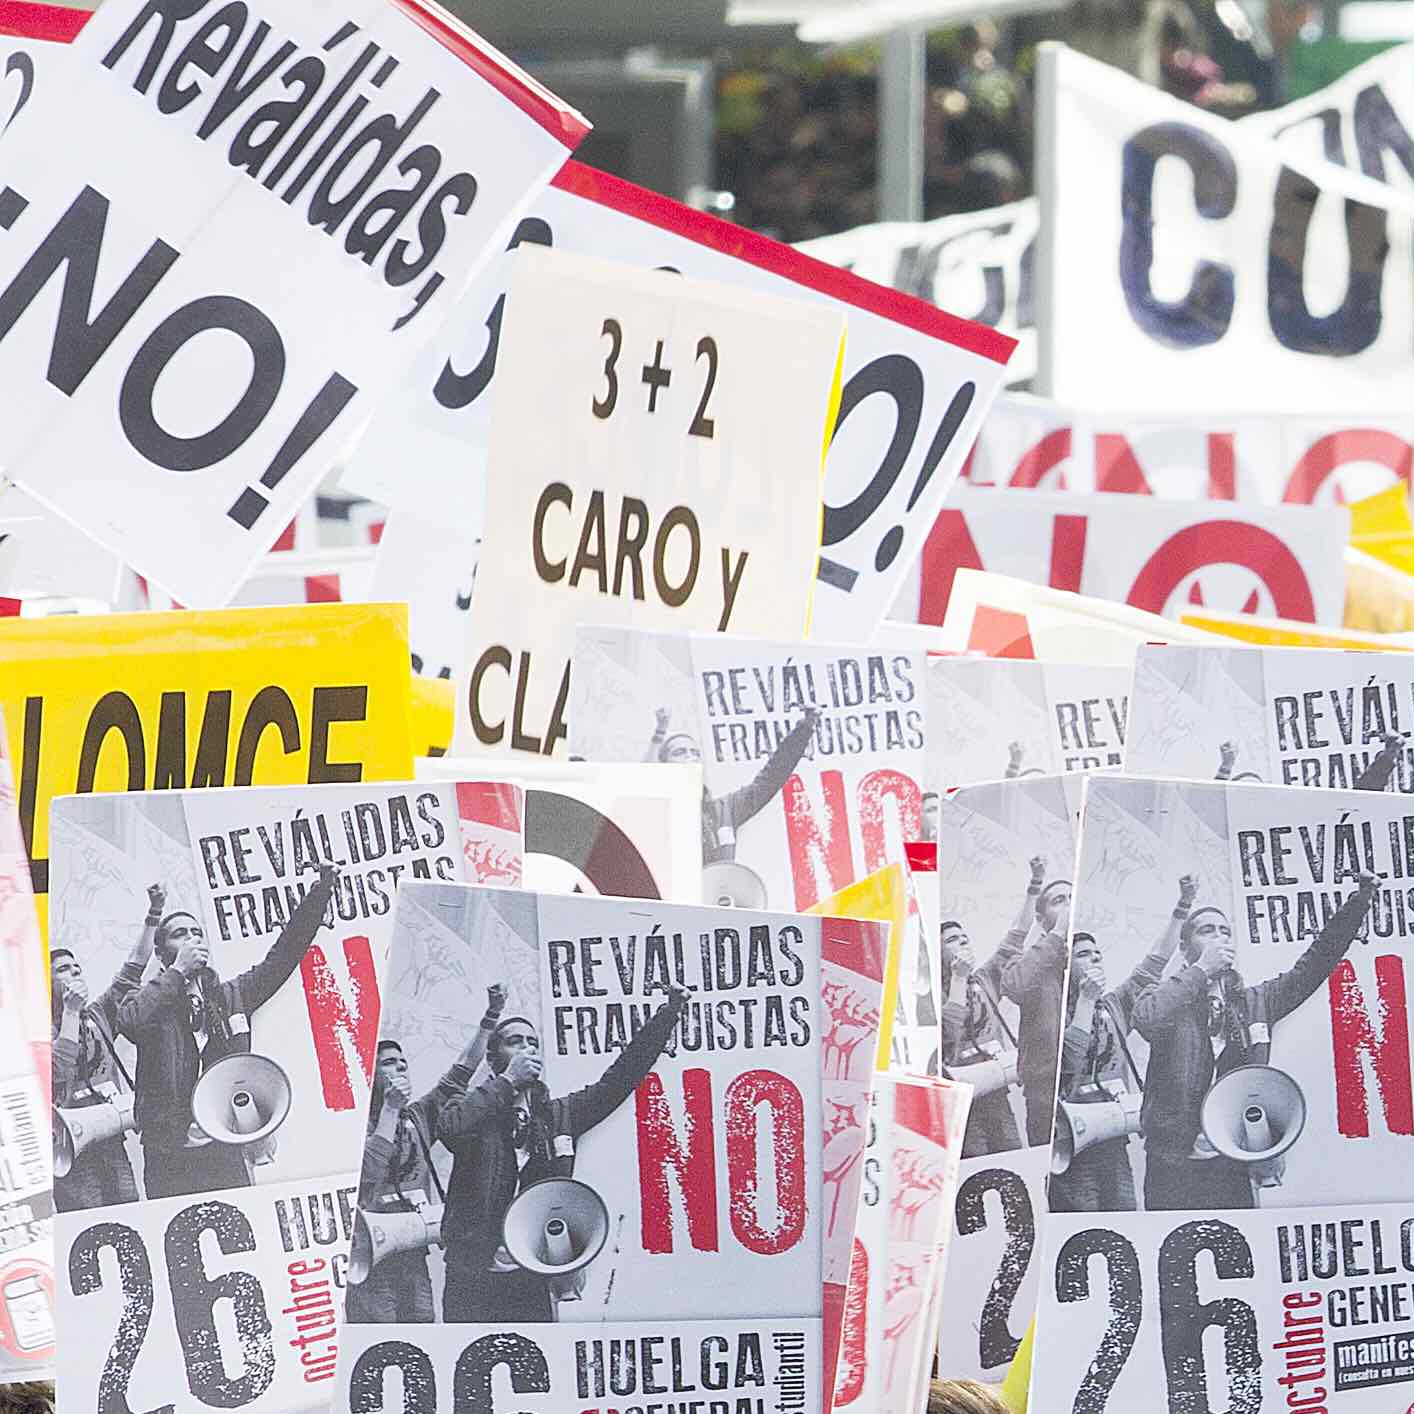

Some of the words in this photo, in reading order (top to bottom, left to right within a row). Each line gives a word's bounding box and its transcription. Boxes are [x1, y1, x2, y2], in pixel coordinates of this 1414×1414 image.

[100, 0, 478, 331] Reválidas,
[0, 185, 359, 530] NO!
[592, 319, 621, 419] 3
[641, 341, 672, 412] +
[688, 337, 718, 438] 2
[533, 482, 700, 607] CARO
[717, 548, 749, 631] y
[702, 655, 915, 718] REVÁLIDAS
[199, 792, 445, 889] REVÁLIDAS
[783, 769, 922, 912] NO
[548, 924, 805, 1003] REVÁLIDAS
[636, 1069, 806, 1257] NO
[283, 1259, 336, 1384] octubre
[575, 1332, 764, 1399] HUELGA
